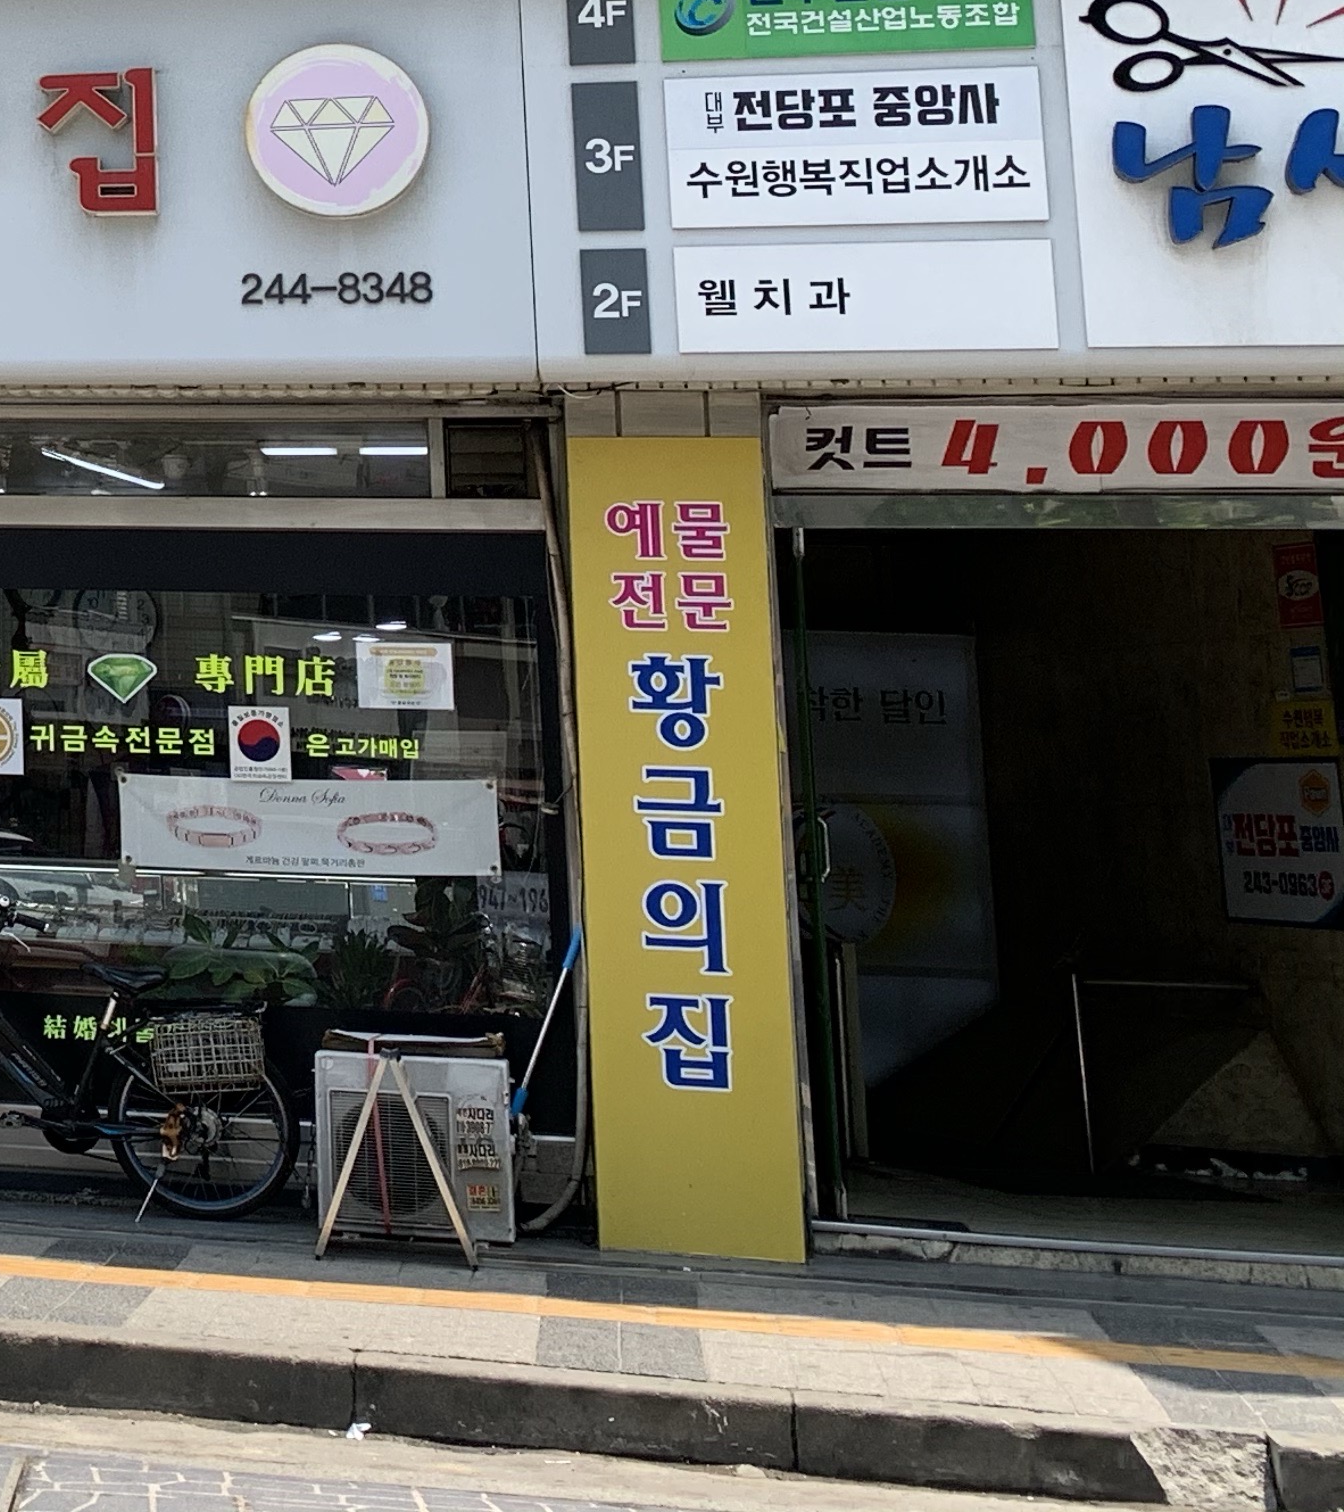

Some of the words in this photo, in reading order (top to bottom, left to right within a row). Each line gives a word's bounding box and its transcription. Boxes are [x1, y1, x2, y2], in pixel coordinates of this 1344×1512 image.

[745, 1, 1021, 37] 전국건설산업노동조합
[732, 89, 856, 131] 전당포
[873, 82, 1001, 127] 중앙사
[584, 138, 635, 174] 3F
[686, 154, 1032, 199] 수원행복직업소개소
[239, 271, 434, 306] 244-8348
[591, 283, 643, 320] 2F
[29, 726, 216, 756] 귀금속전문점
[335, 737, 420, 760] 고가매입
[258, 787, 308, 805] Donna
[310, 787, 346, 807] Sofia
